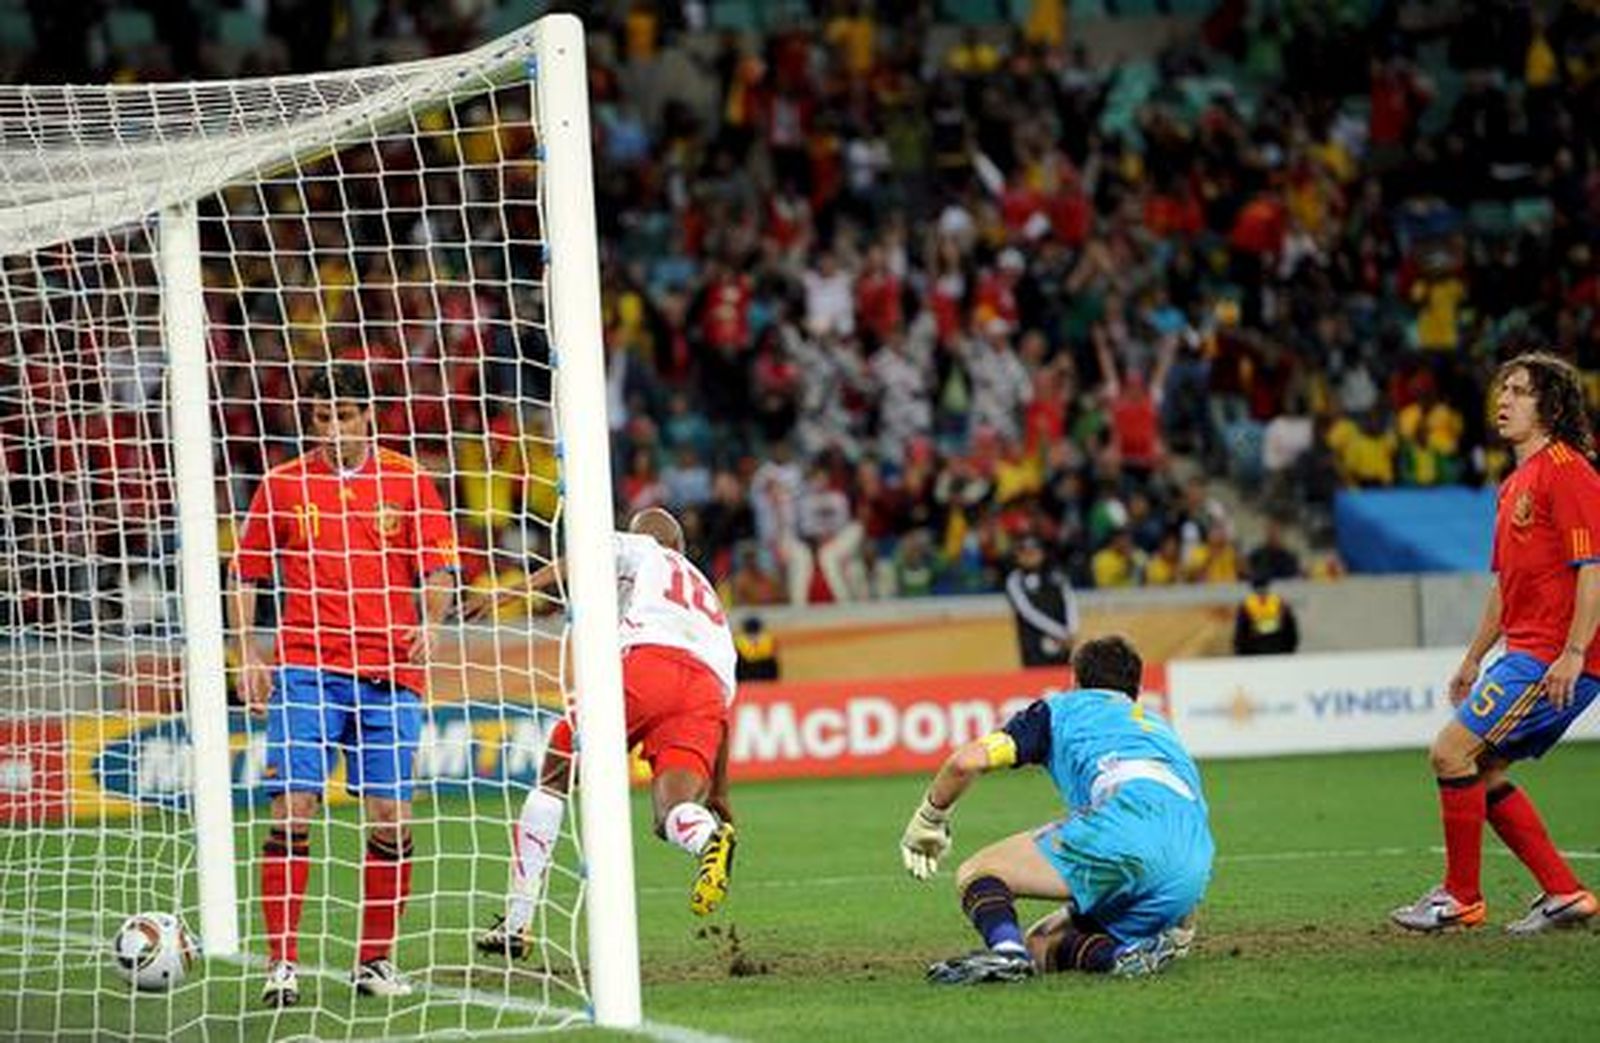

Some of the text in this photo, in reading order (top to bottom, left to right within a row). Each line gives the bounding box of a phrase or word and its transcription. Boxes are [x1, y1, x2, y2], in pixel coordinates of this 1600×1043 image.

[1305, 687, 1435, 718] YINGLI
[1471, 684, 1504, 717] 5
[732, 695, 1022, 760] McDon
